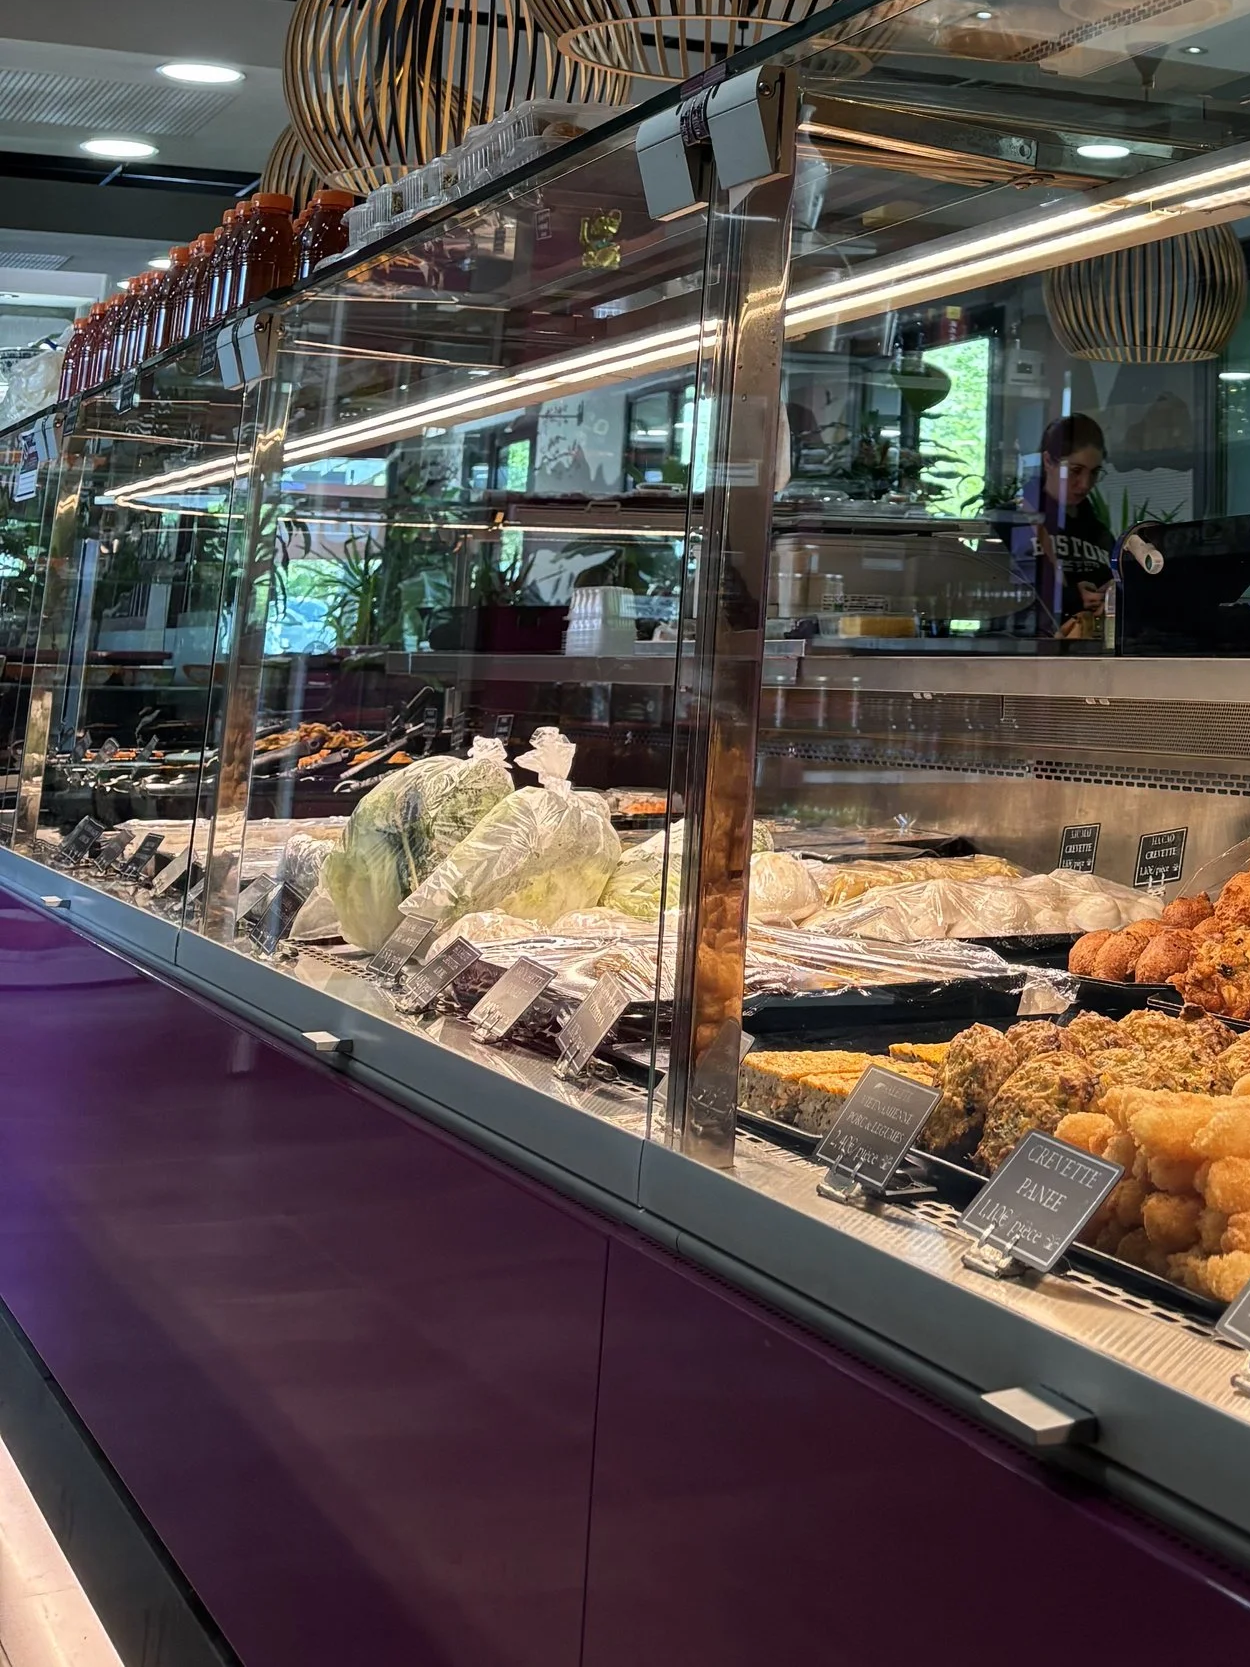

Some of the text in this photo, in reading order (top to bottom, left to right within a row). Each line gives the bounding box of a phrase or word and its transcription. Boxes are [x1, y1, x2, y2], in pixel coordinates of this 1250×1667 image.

[1065, 843, 1093, 854] CREVETTE
[1145, 847, 1177, 860] CREVETTE
[874, 1082, 914, 1103] ALETTE
[846, 1111, 868, 1128] PORC
[871, 1122, 905, 1144] LEGUMES
[1027, 1144, 1102, 1189] CREVETTE
[1016, 1177, 1067, 1213] PANEE
